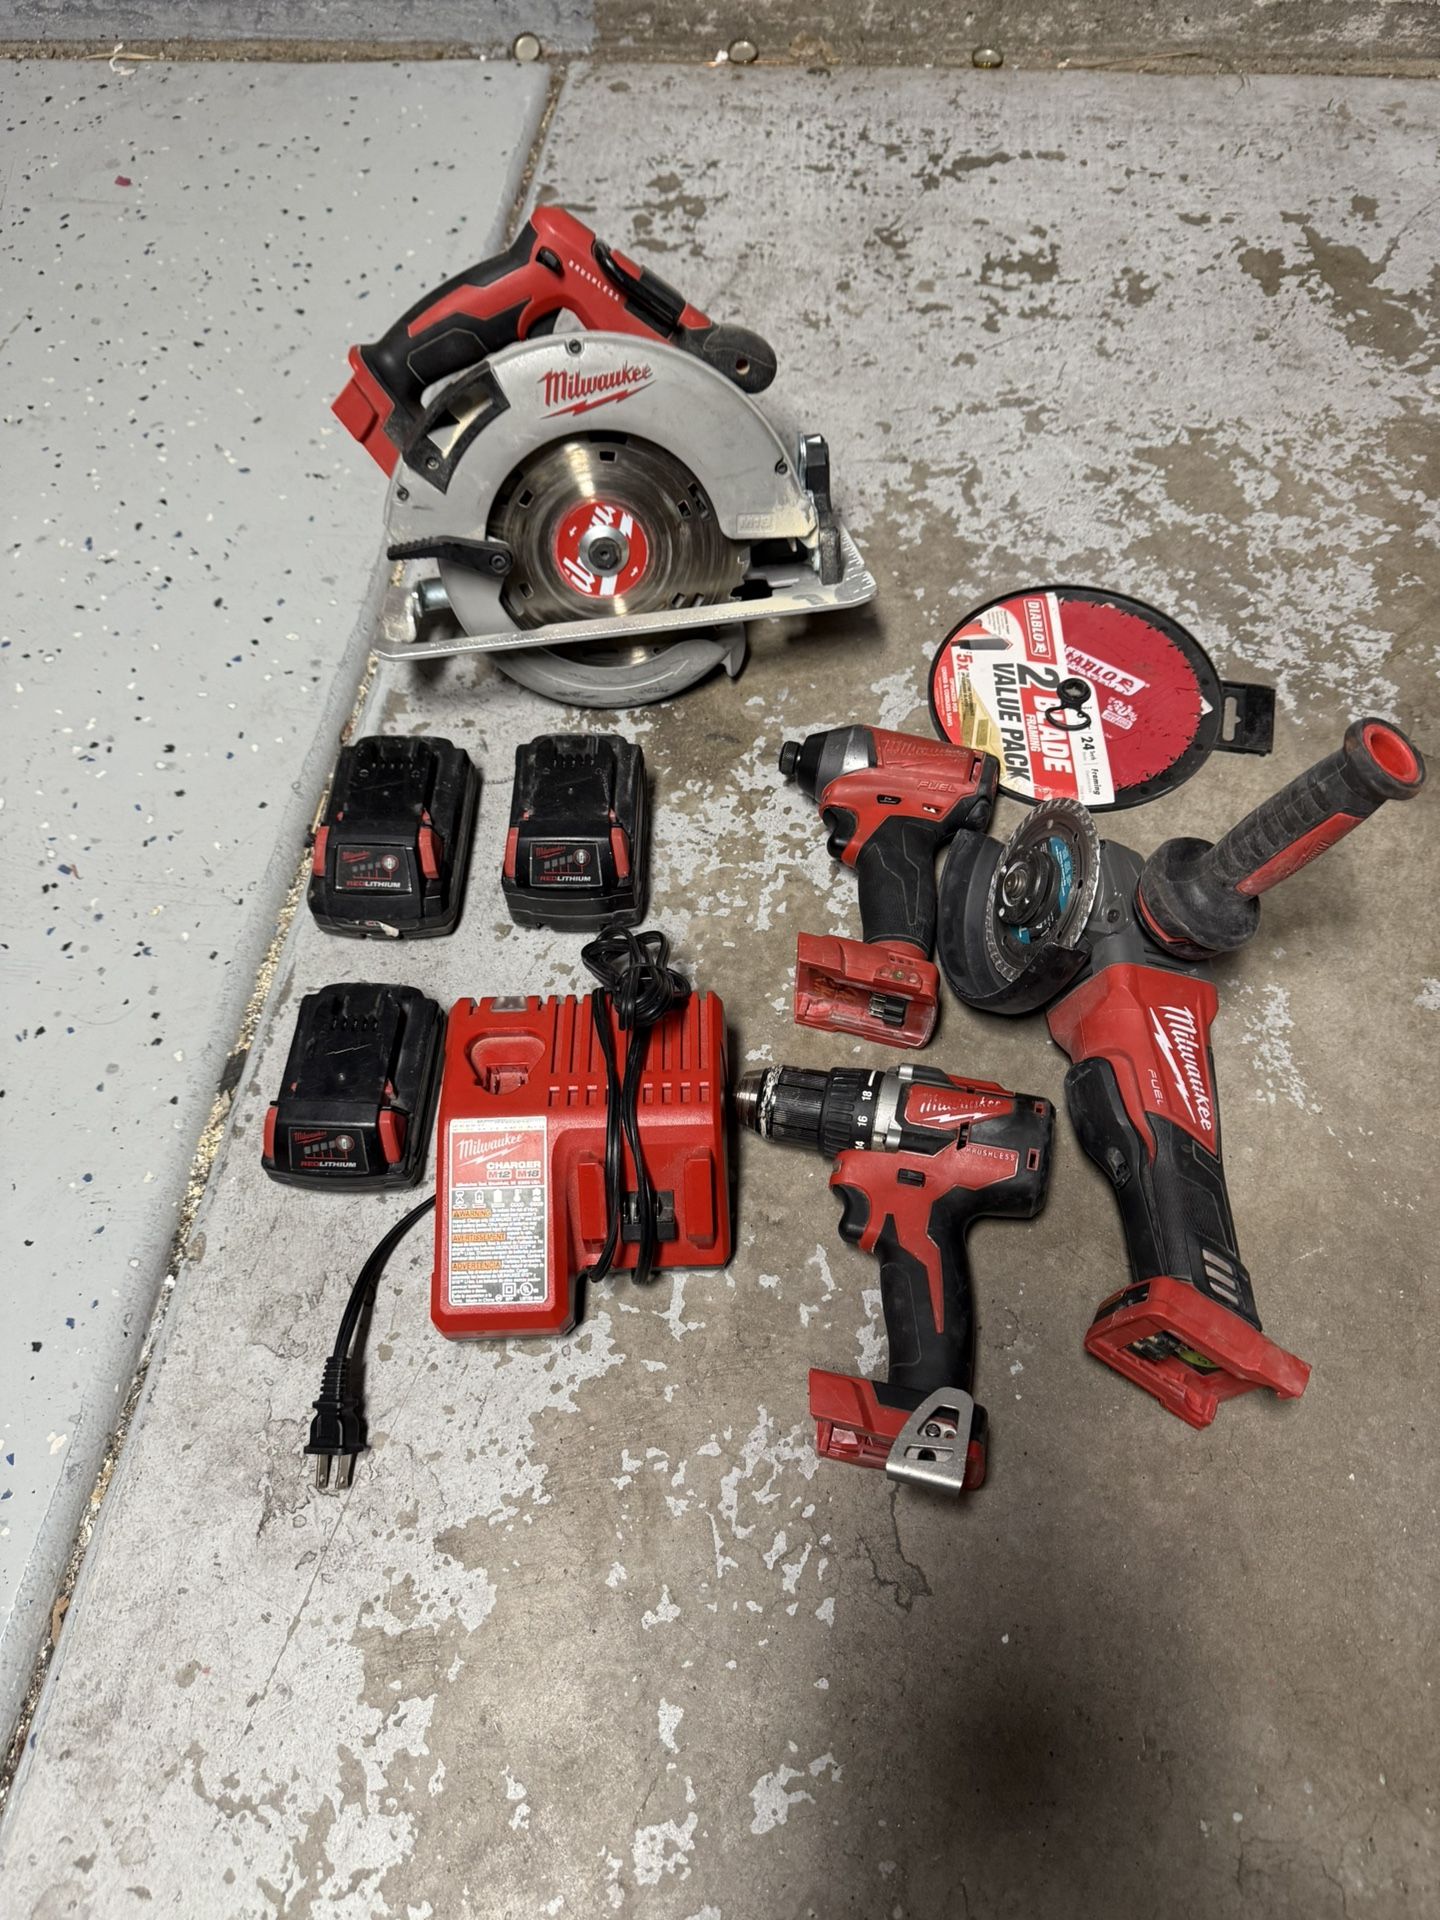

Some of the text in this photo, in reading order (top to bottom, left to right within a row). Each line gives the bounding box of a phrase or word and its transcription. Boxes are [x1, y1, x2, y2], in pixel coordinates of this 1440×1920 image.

[568, 259, 620, 302] BRUSHLESS
[537, 360, 653, 407] Milwaukee
[1027, 601, 1045, 644] DIABLO
[992, 663, 1022, 723] VALUE
[1025, 713, 1041, 753] FRAMING
[1033, 695, 1073, 774] BLADE
[1081, 736, 1094, 751] 24
[1001, 727, 1031, 782] PACK
[918, 781, 957, 793] FUEL
[1091, 768, 1100, 795] Framing
[1158, 1006, 1212, 1131] Milwaukee
[861, 1090, 873, 1102] 18
[1148, 1068, 1164, 1105] FUEL
[857, 1115, 869, 1127] 16
[456, 1132, 524, 1160] Milwaukee
[854, 1140, 865, 1150] 14
[486, 1160, 541, 1170] CHARGER
[488, 1169, 540, 1178] M12 M18
[459, 1209, 491, 1217] WARNING
[453, 1232, 505, 1242] AVERTISSEMENT
[453, 1261, 501, 1270] ADVERTENCIA
